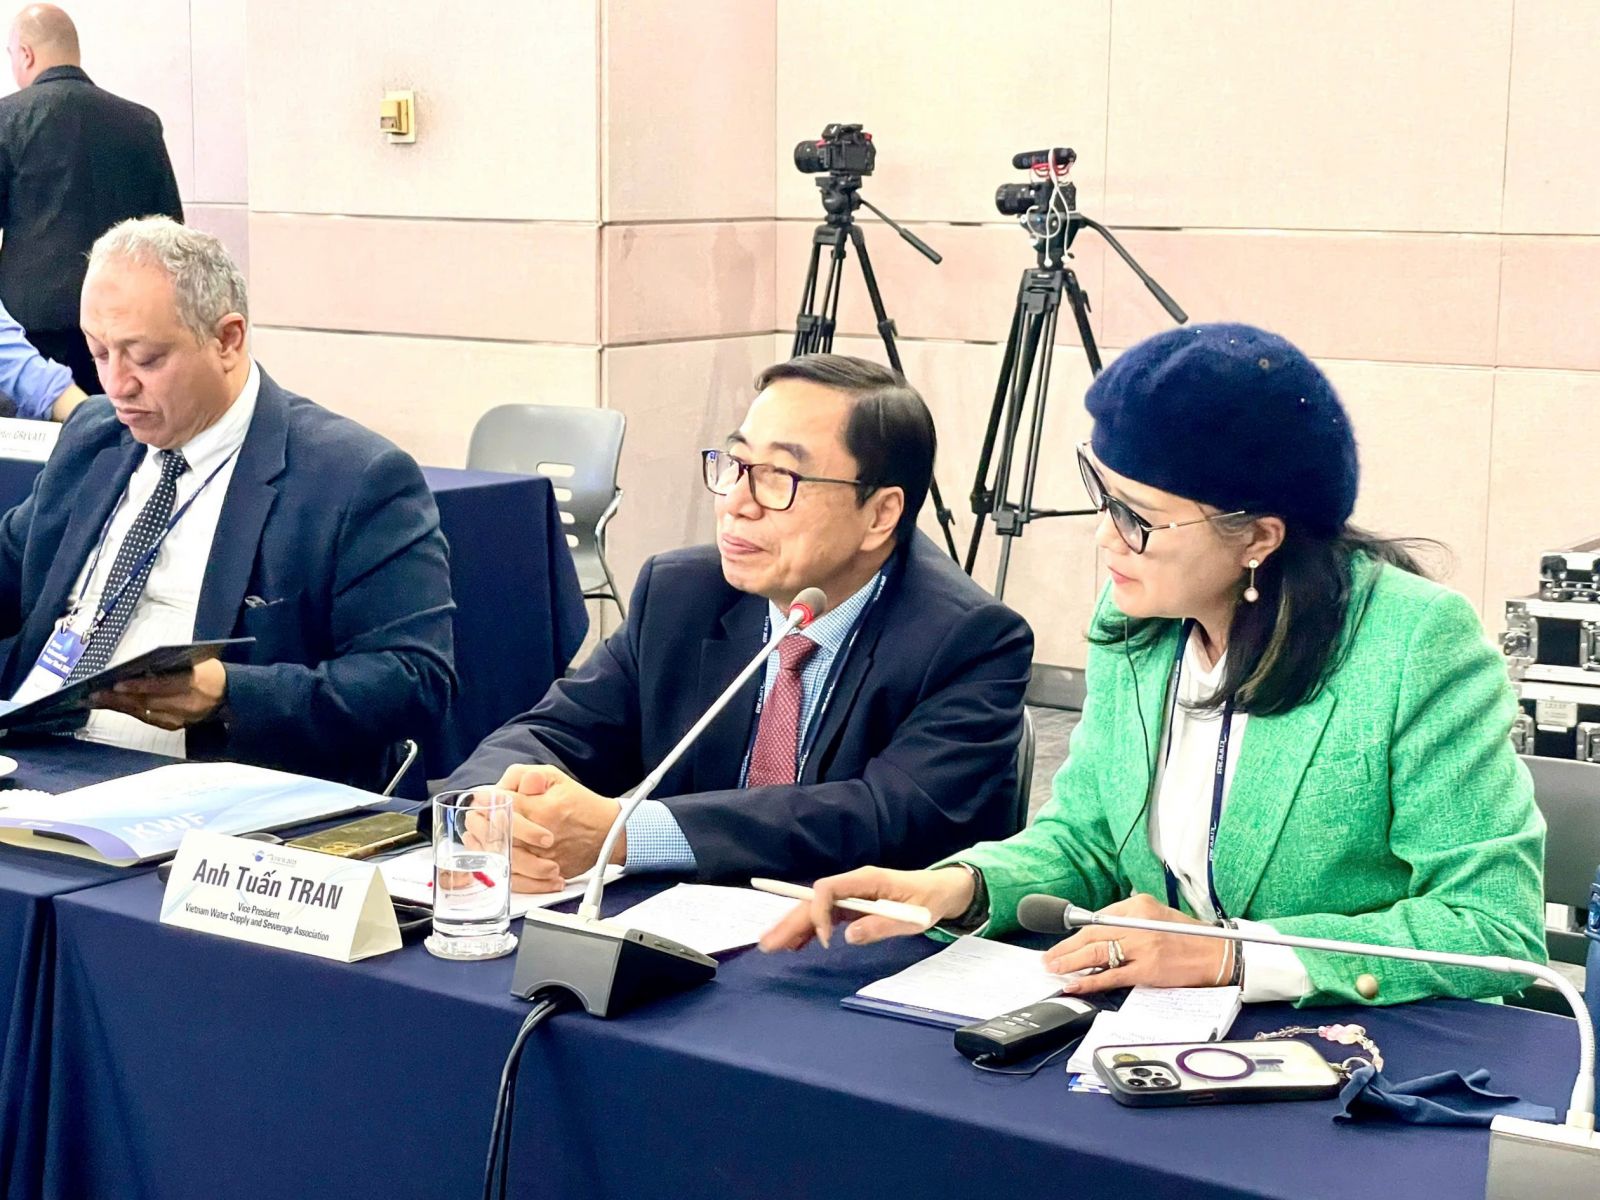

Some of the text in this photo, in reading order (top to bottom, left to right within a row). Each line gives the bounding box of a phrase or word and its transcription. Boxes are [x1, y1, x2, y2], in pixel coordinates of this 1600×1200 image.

[192, 858, 230, 888] Anh
[235, 865, 283, 898] Tuấn
[288, 876, 344, 910] TRAN
[185, 902, 330, 941] Vietnam Water Supply and Sewerage Association
[238, 902, 280, 920] Vice President
